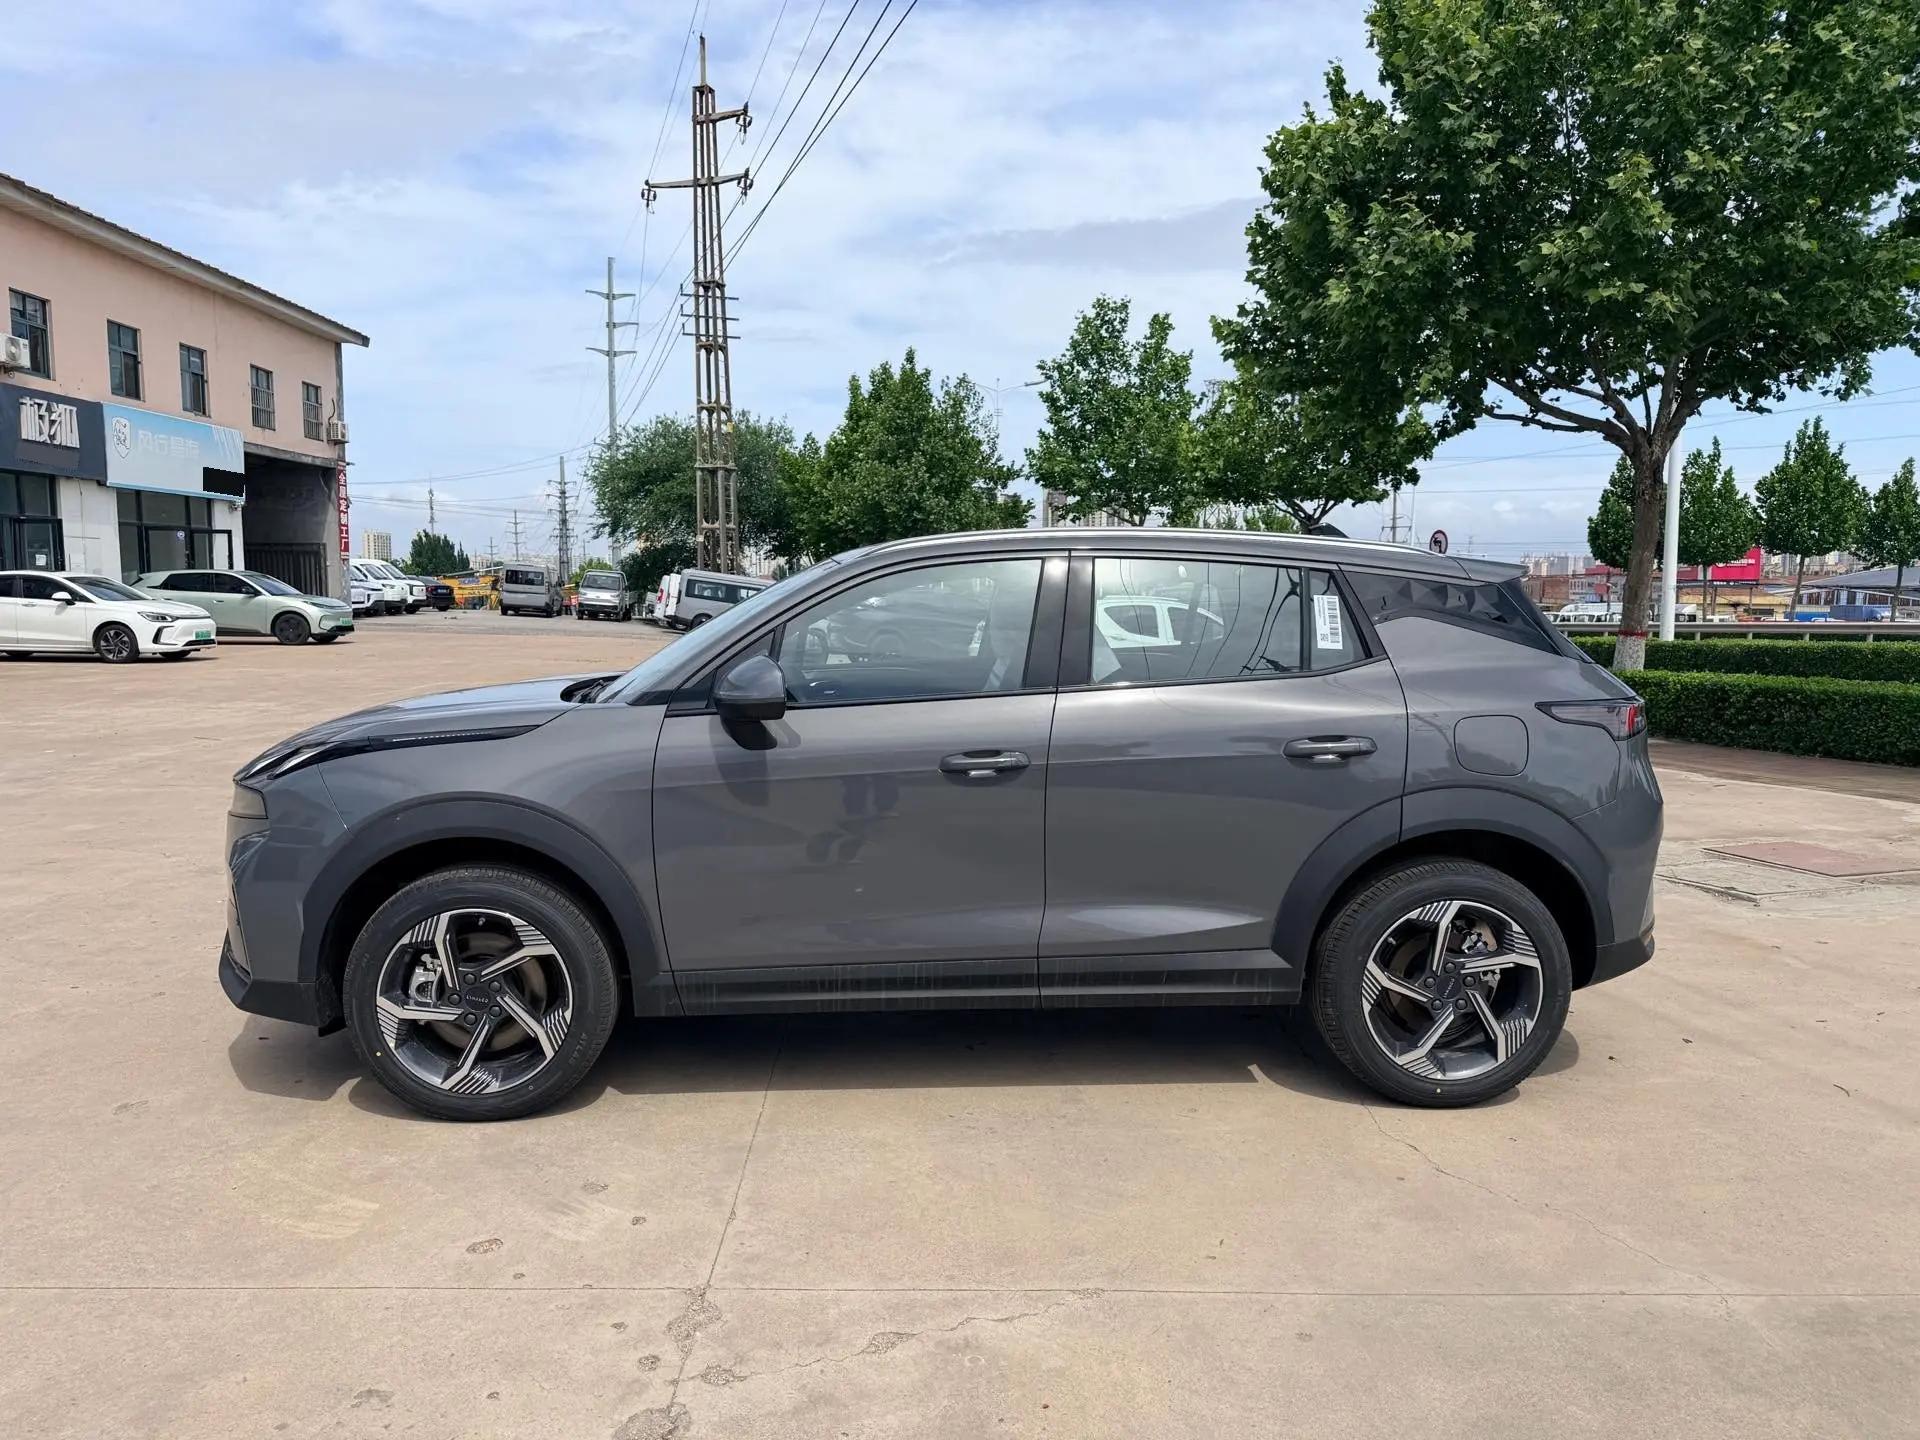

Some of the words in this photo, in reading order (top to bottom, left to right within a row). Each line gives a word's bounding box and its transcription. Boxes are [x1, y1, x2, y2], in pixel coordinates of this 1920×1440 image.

[19, 396, 80, 449] 极狐
[138, 429, 201, 459] 风行星海
[338, 471, 349, 550] 全屋定制工厂
